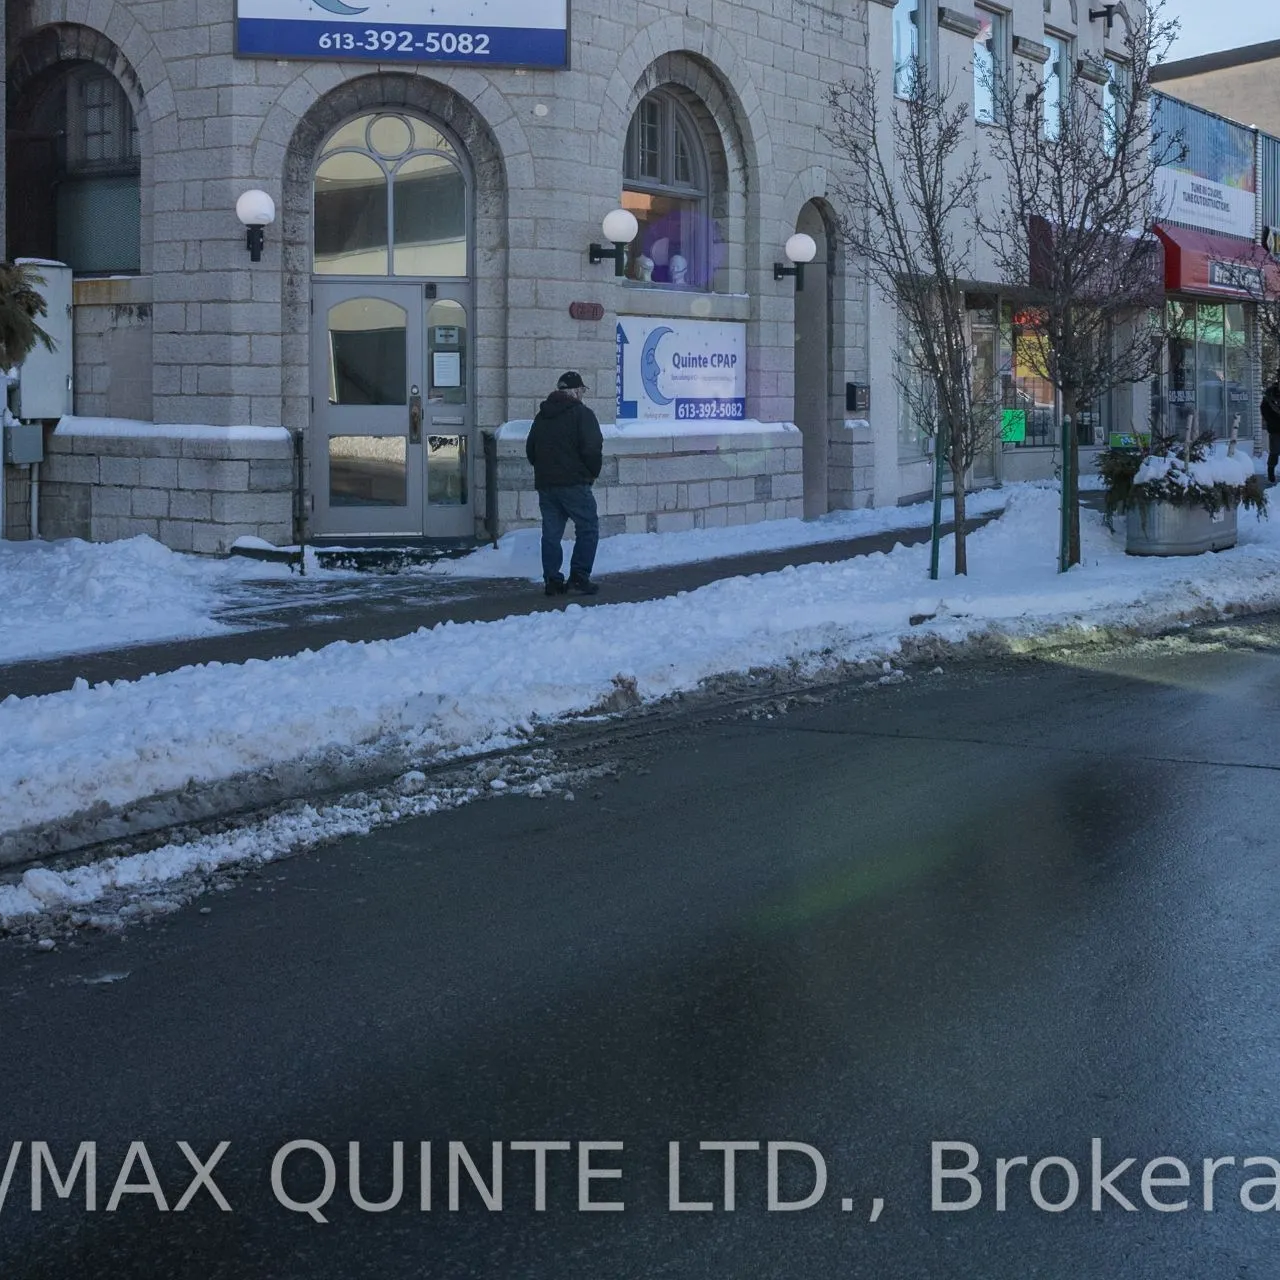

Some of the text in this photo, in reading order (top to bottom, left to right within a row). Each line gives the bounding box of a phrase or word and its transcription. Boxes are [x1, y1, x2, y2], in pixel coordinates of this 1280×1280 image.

[318, 29, 490, 55] 613-392-5082
[672, 352, 737, 369] Quinte CPAP
[678, 402, 742, 418] 613-392-5082
